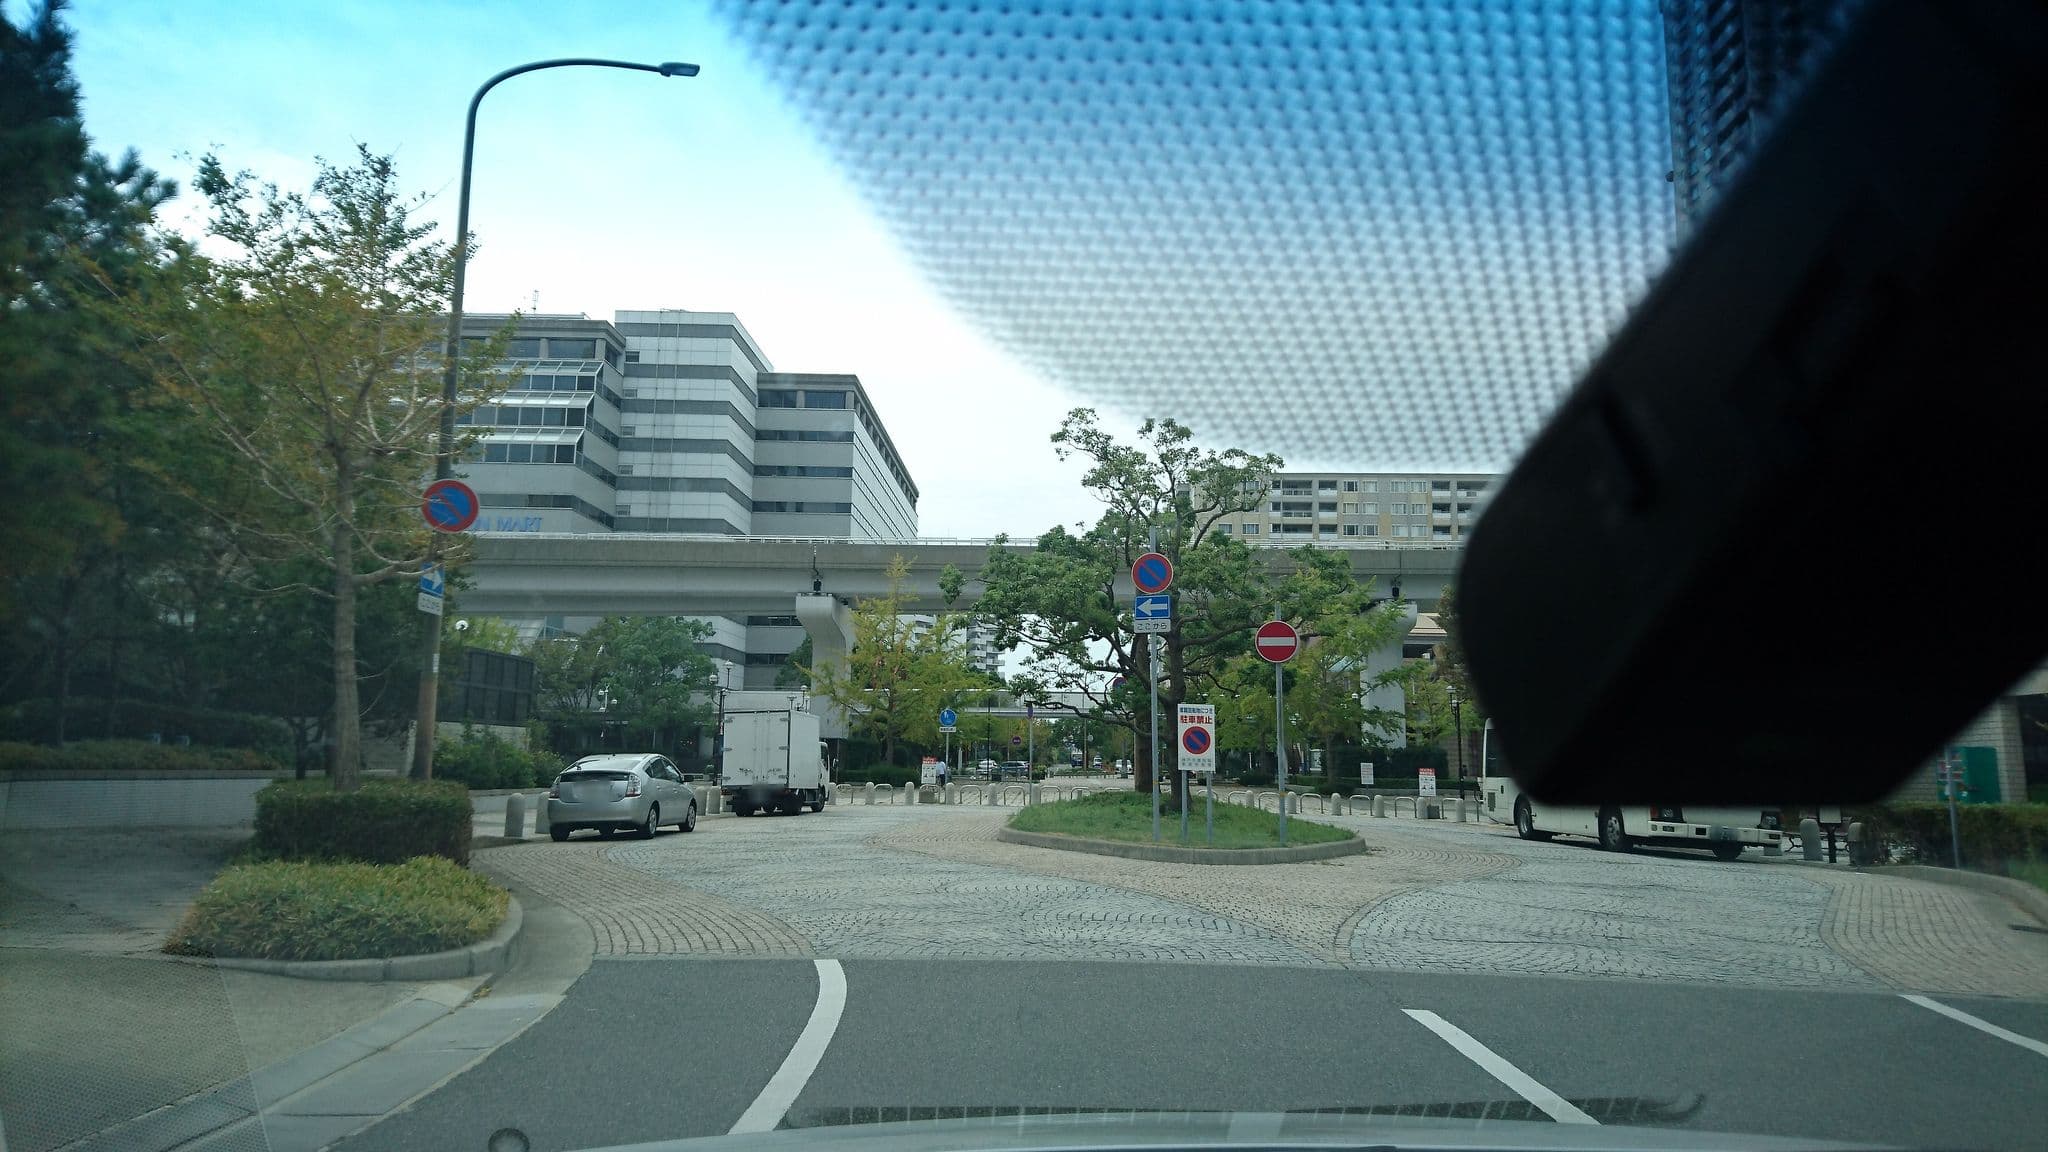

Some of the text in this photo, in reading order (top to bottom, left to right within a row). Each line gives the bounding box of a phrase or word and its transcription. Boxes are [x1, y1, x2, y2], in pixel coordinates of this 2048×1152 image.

[497, 517, 542, 532] MART
[1137, 622, 1167, 631] ここから
[1180, 715, 1213, 724] 駐車禁止
